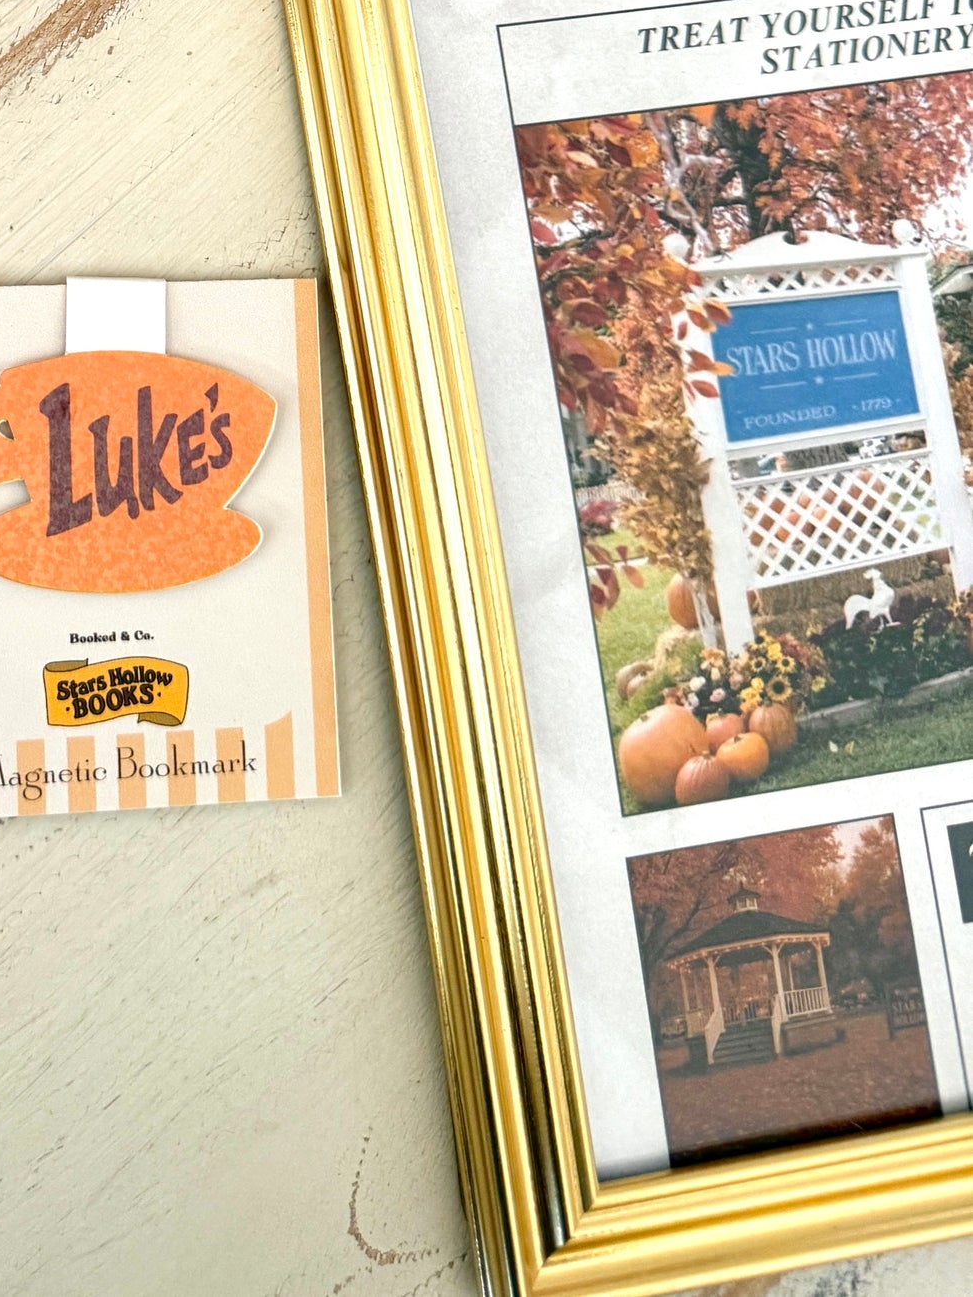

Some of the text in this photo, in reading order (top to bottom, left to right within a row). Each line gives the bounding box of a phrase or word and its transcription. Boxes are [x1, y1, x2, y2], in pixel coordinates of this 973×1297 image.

[638, 16, 749, 53] TREAT
[760, 23, 973, 75] STATIONERY
[727, 329, 897, 376] STARS HOLLOW
[744, 397, 892, 430] FOUNDED 1779
[69, 630, 154, 643] Booked & Co.
[56, 666, 173, 700] Stars Hollow
[72, 683, 154, 719] BOOKS
[116, 740, 258, 780] Bookmark
